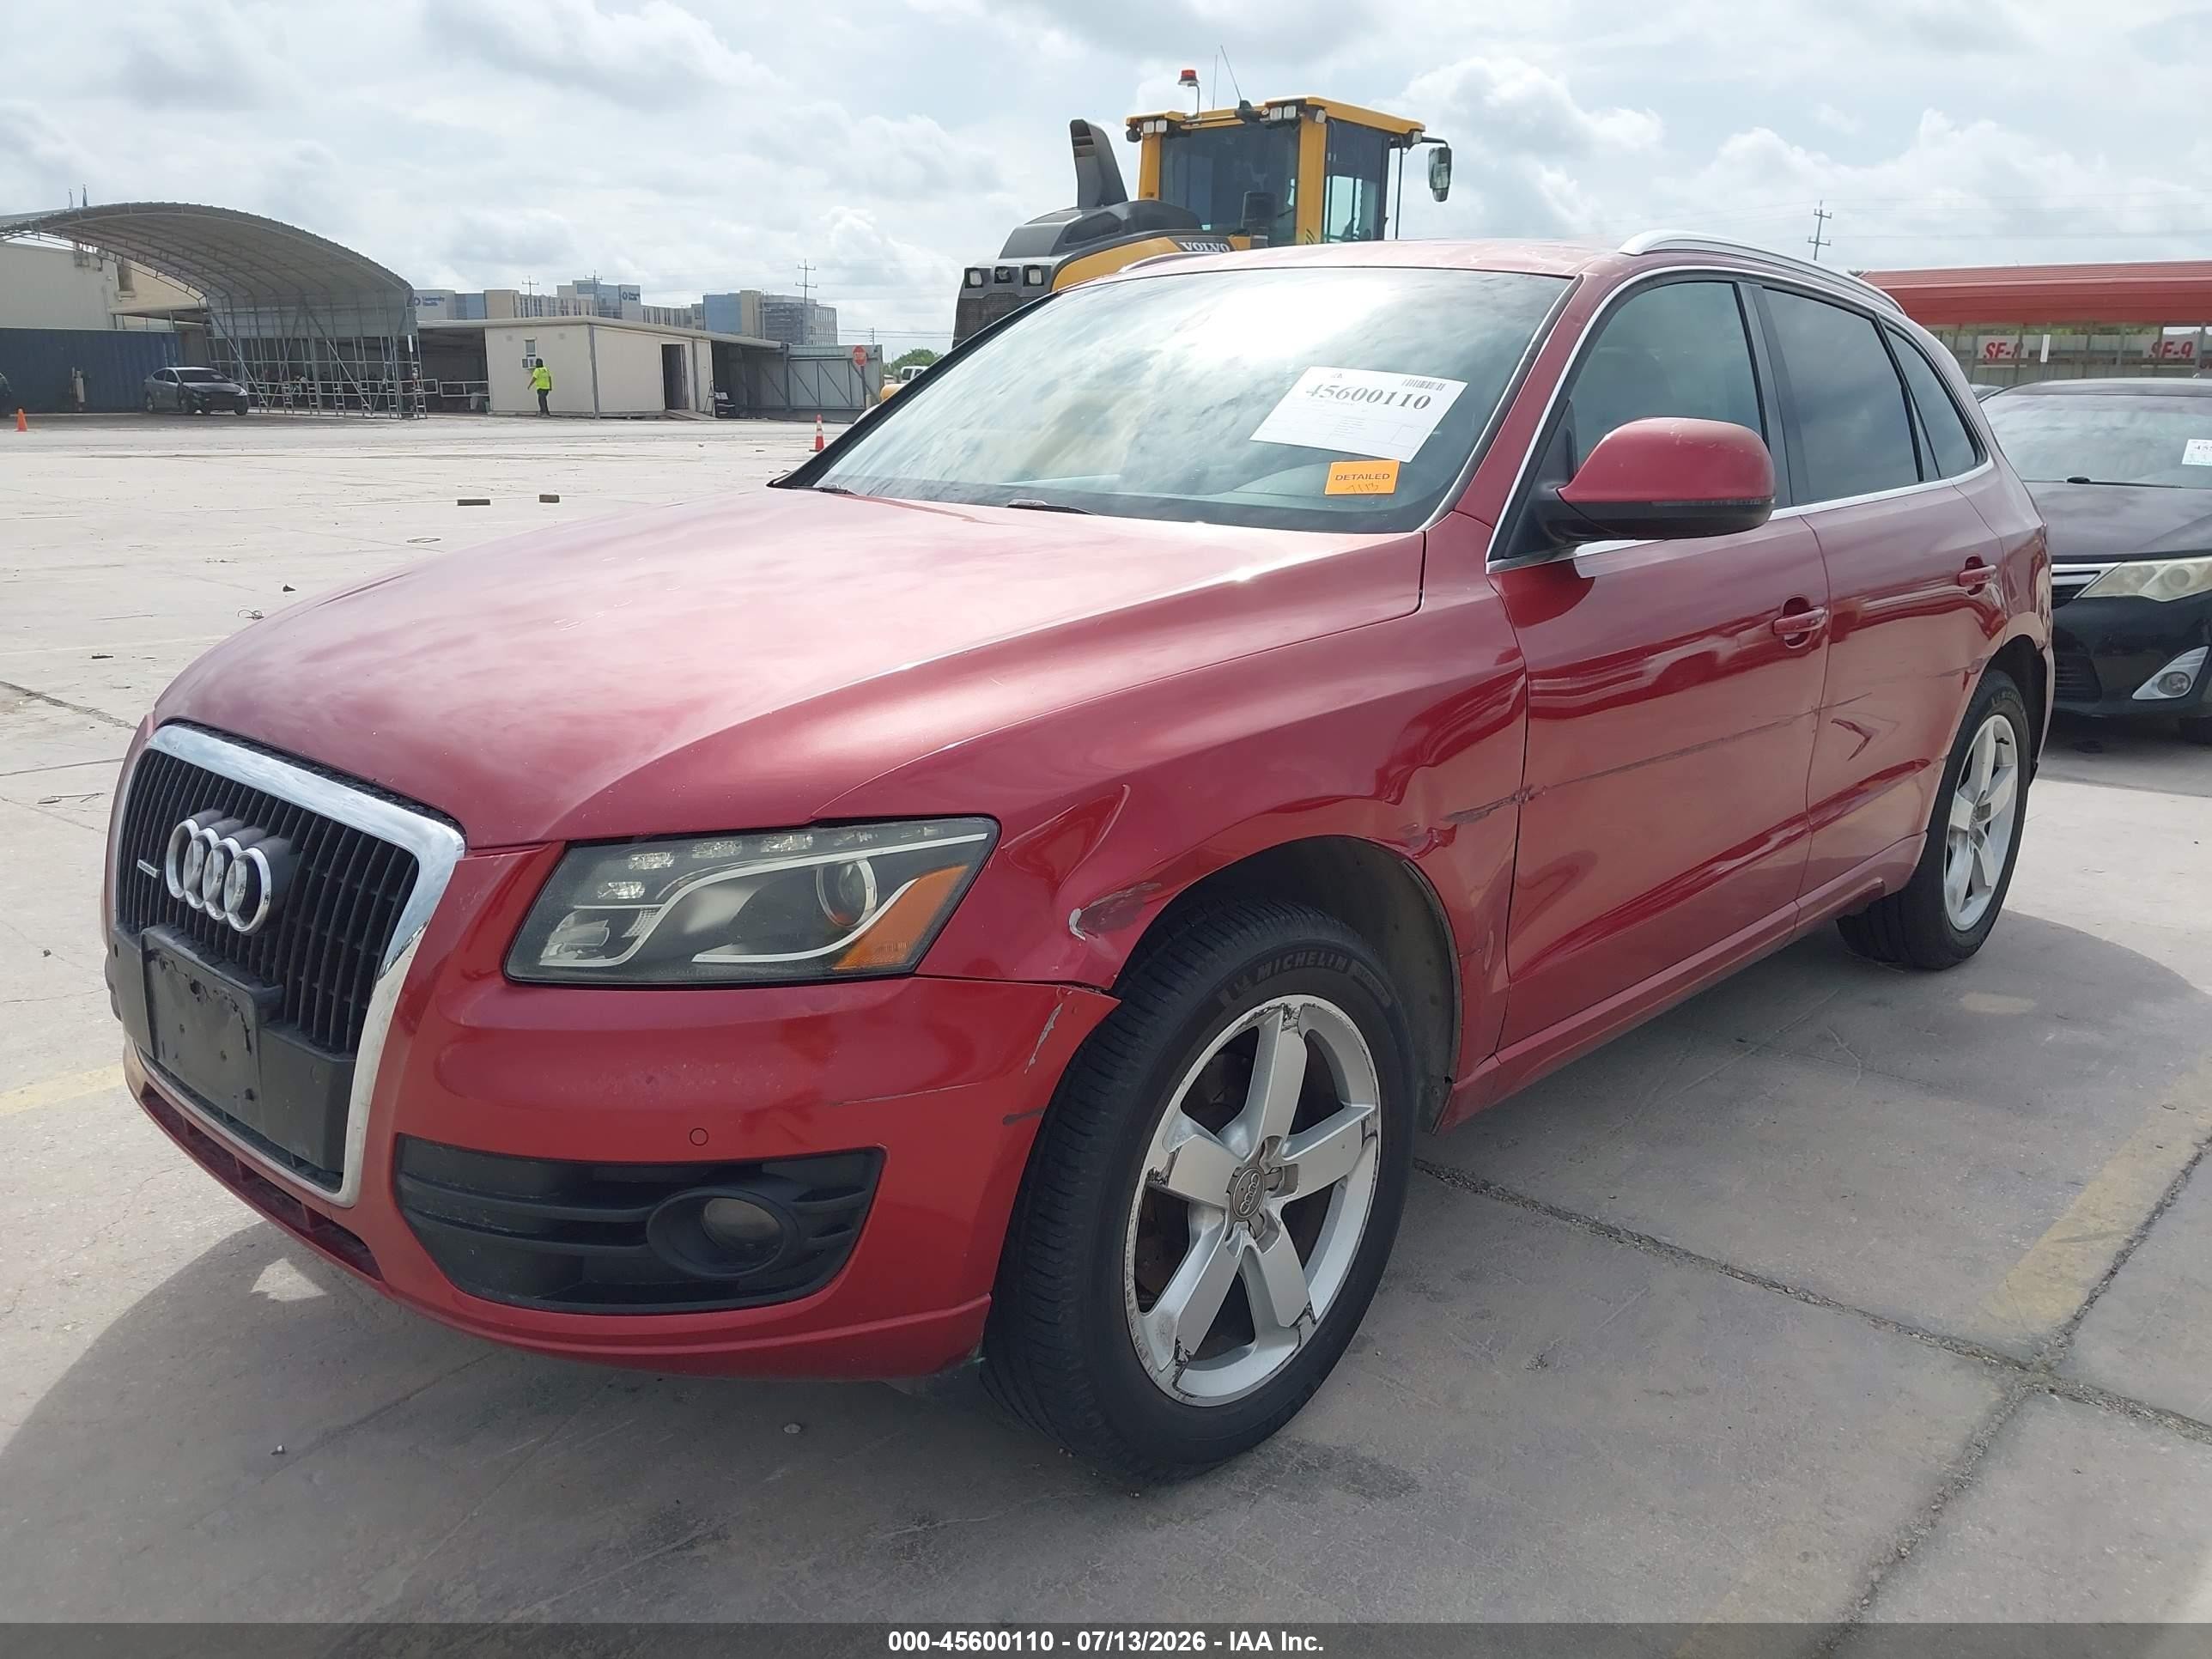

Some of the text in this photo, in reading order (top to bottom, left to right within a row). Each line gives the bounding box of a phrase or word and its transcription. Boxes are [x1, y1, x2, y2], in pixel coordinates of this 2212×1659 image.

[1179, 241, 1231, 252] VOLVO
[1306, 383, 1432, 410] 45600110
[1257, 951, 1348, 982] MICHELIN
